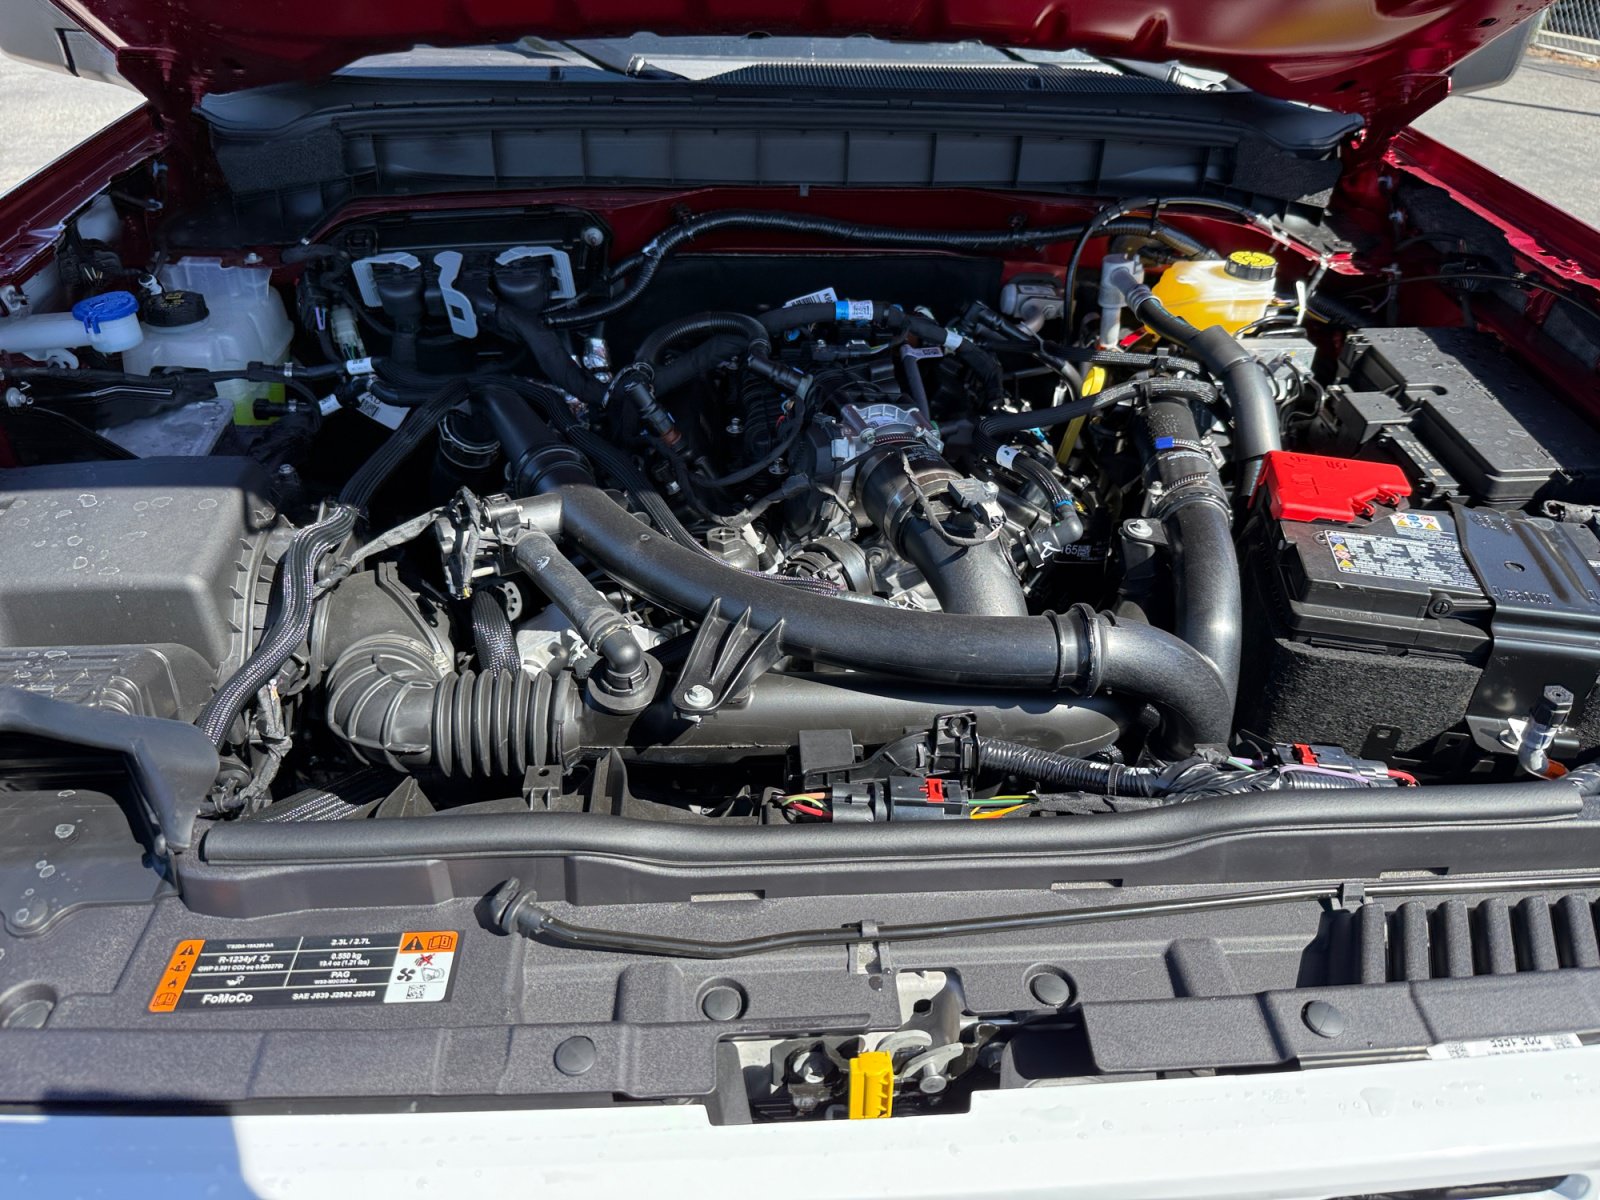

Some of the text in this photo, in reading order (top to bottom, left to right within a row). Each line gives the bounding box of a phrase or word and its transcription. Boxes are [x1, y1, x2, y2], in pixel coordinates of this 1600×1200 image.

[330, 938, 348, 946] 2.3L
[218, 955, 258, 964] R-1234yf
[351, 952, 362, 960] kg
[201, 992, 253, 1004] FoMoCo
